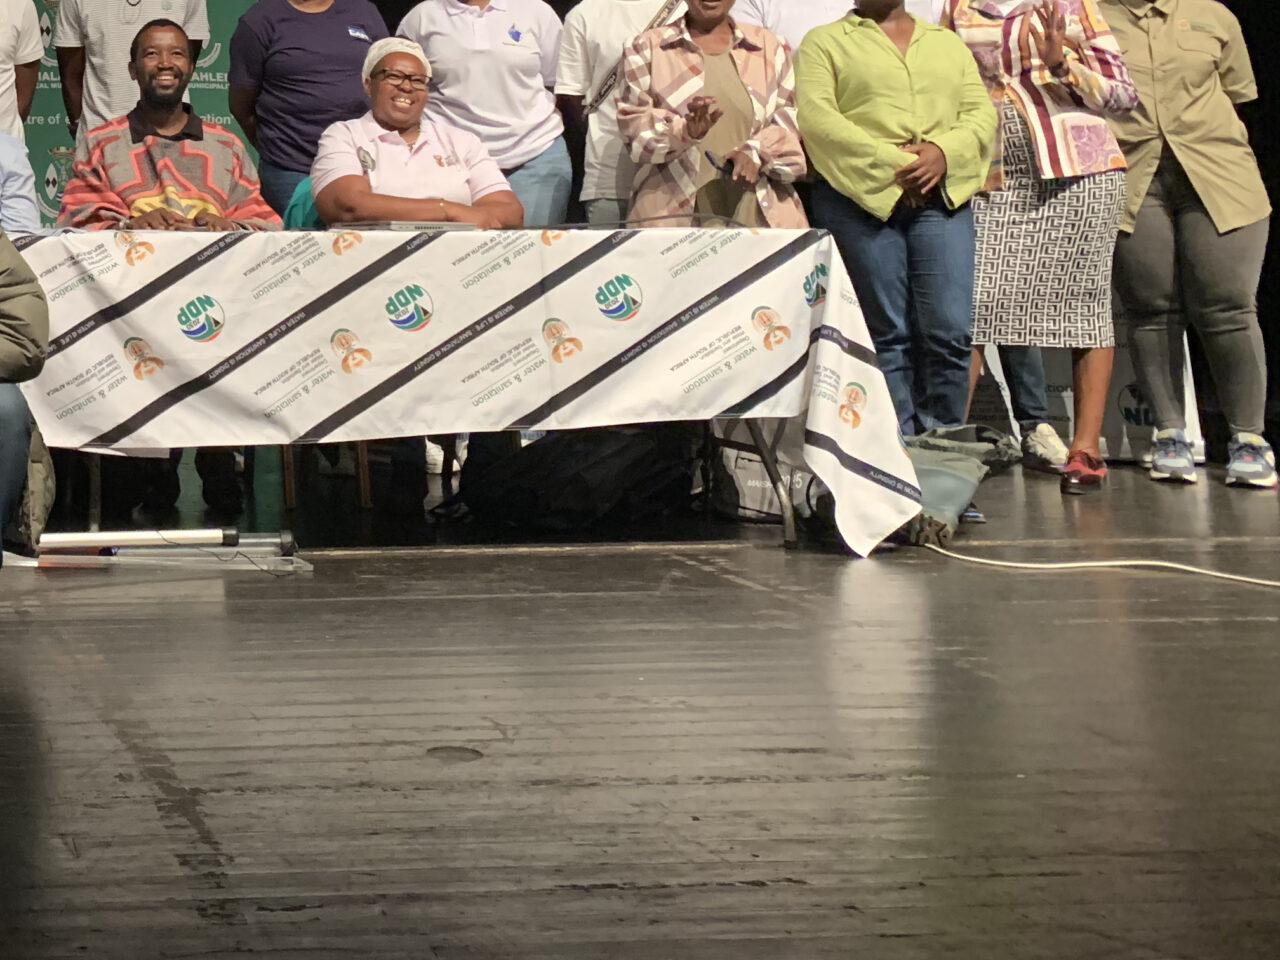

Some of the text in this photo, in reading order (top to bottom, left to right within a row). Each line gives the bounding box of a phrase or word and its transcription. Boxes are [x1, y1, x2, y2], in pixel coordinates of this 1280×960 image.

[47, 113, 60, 124] of
[718, 228, 743, 248] water
[195, 244, 219, 261] DIGNITY
[470, 241, 489, 255] SOUTH
[659, 241, 679, 255] AFRICA
[709, 244, 719, 255] &
[260, 251, 279, 264] SOUTH
[451, 252, 471, 267] AFRICA
[462, 240, 536, 291] water & sanitation
[670, 250, 710, 280] sanitation
[38, 264, 57, 278] AFRICA
[242, 262, 262, 276] AFRICA
[252, 249, 326, 301] water & sanitation
[86, 272, 96, 283] &
[48, 275, 88, 303] sanitation
[594, 273, 633, 306] NDP
[384, 283, 424, 315] NDP
[698, 294, 719, 310] WATER
[177, 294, 216, 326] NDP
[493, 303, 514, 319] WATER
[680, 310, 693, 321] LIFE
[285, 311, 305, 327] WATER
[474, 319, 488, 331] LIFE
[268, 328, 280, 339] LIFE
[619, 344, 642, 362] DIGNITY
[688, 345, 707, 360] SOUTH
[412, 353, 435, 371] DIGNITY
[479, 357, 499, 372] SOUTH
[669, 357, 690, 372] AFRICA
[682, 344, 757, 396] water & sanitation
[64, 372, 84, 386] SOUTH
[207, 362, 230, 380] DIGNITY
[270, 369, 289, 383] SOUTH
[460, 369, 481, 384] AFRICA
[46, 383, 66, 396] AFRICA
[252, 380, 272, 396] AFRICA
[471, 357, 546, 408] water & sanitation
[55, 373, 127, 422] water & sanitation
[264, 367, 335, 420] water & sanitation
[868, 469, 896, 486] DIGNITY
